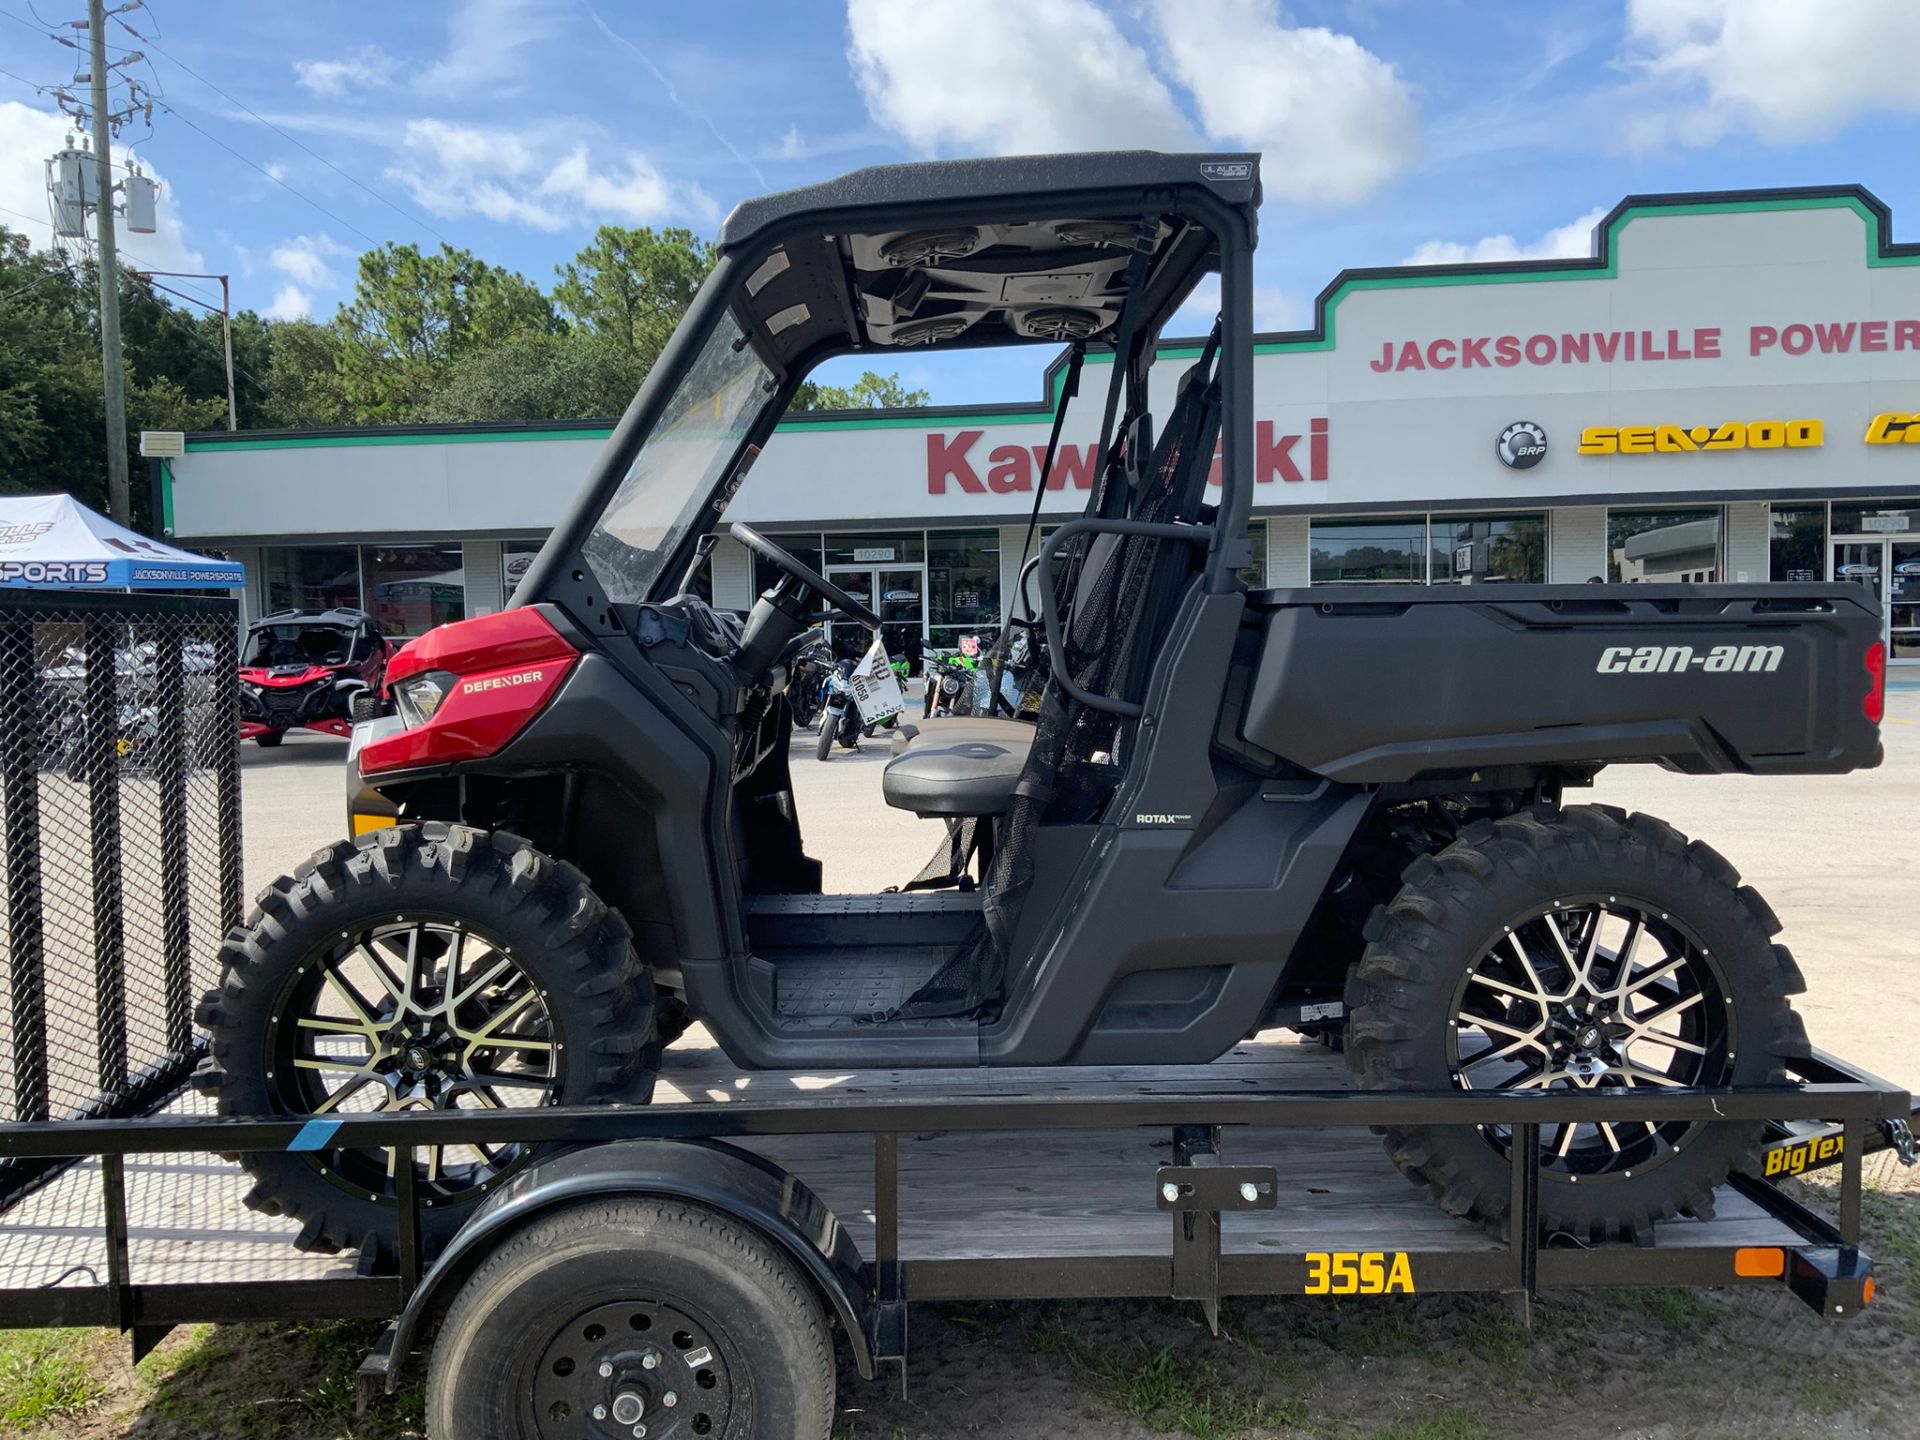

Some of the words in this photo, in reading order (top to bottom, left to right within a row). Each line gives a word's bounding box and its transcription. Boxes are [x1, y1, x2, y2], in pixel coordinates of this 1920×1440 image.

[1370, 327, 1722, 373] JACKSONVILLE
[926, 417, 1329, 495] Kawki
[1517, 446, 1546, 457] BRP
[858, 549, 892, 559] 10290
[0, 561, 109, 583] PORTS
[132, 569, 187, 581] JACKSONVILLE
[190, 571, 243, 583] POWERSPORTS
[1596, 645, 1785, 673] can-am
[463, 670, 543, 695] DEFENDER
[1136, 814, 1175, 824] ROTAX
[1304, 1251, 1416, 1295] 35SA
